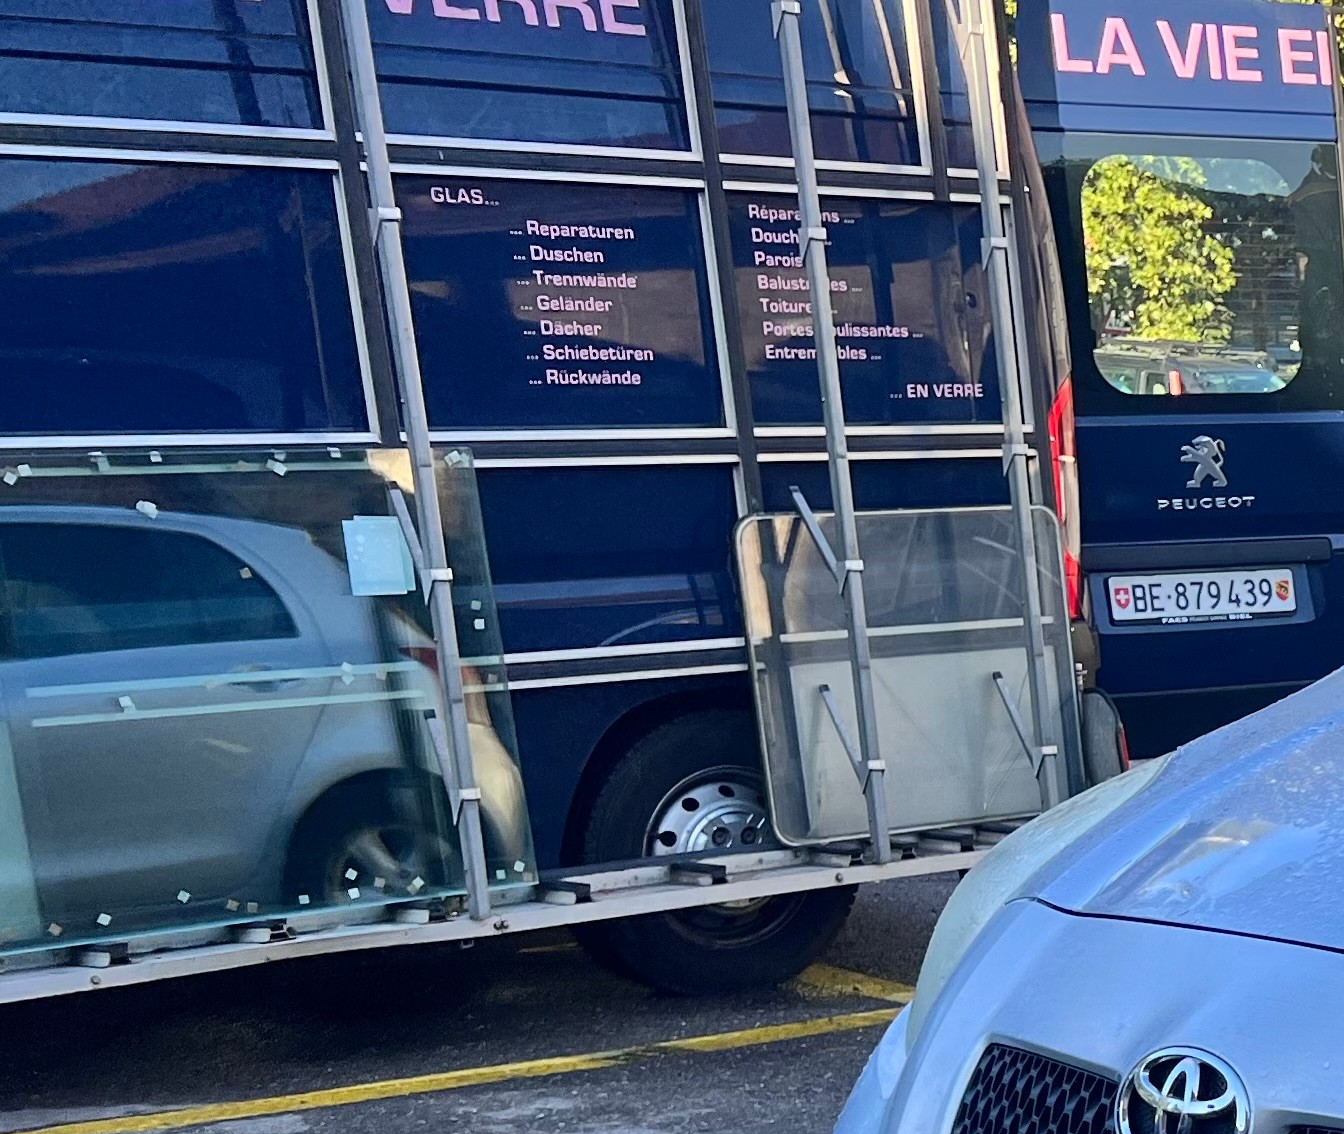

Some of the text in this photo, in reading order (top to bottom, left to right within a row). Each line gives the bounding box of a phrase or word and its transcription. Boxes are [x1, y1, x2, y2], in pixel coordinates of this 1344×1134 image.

[1050, 13, 1146, 76] LA
[1156, 20, 1263, 82] VIE
[748, 203, 840, 224] Réparans
[526, 219, 635, 240] Reparaturen
[751, 227, 800, 244] Douch
[529, 245, 605, 263] Duschen
[532, 269, 638, 289] Trennwände
[757, 274, 848, 292] Balustes
[536, 295, 614, 312] Geländer
[759, 297, 812, 314] Toiture
[540, 319, 602, 336] Dächer
[762, 321, 814, 338] Portes
[836, 322, 910, 338] ulissantes
[542, 344, 654, 361] Schiebetüren
[765, 344, 868, 361] Entrembles
[545, 368, 642, 386] Rückwände
[906, 383, 929, 398] EN
[932, 383, 984, 398] VERRE
[1157, 496, 1256, 511] PEUGEOT
